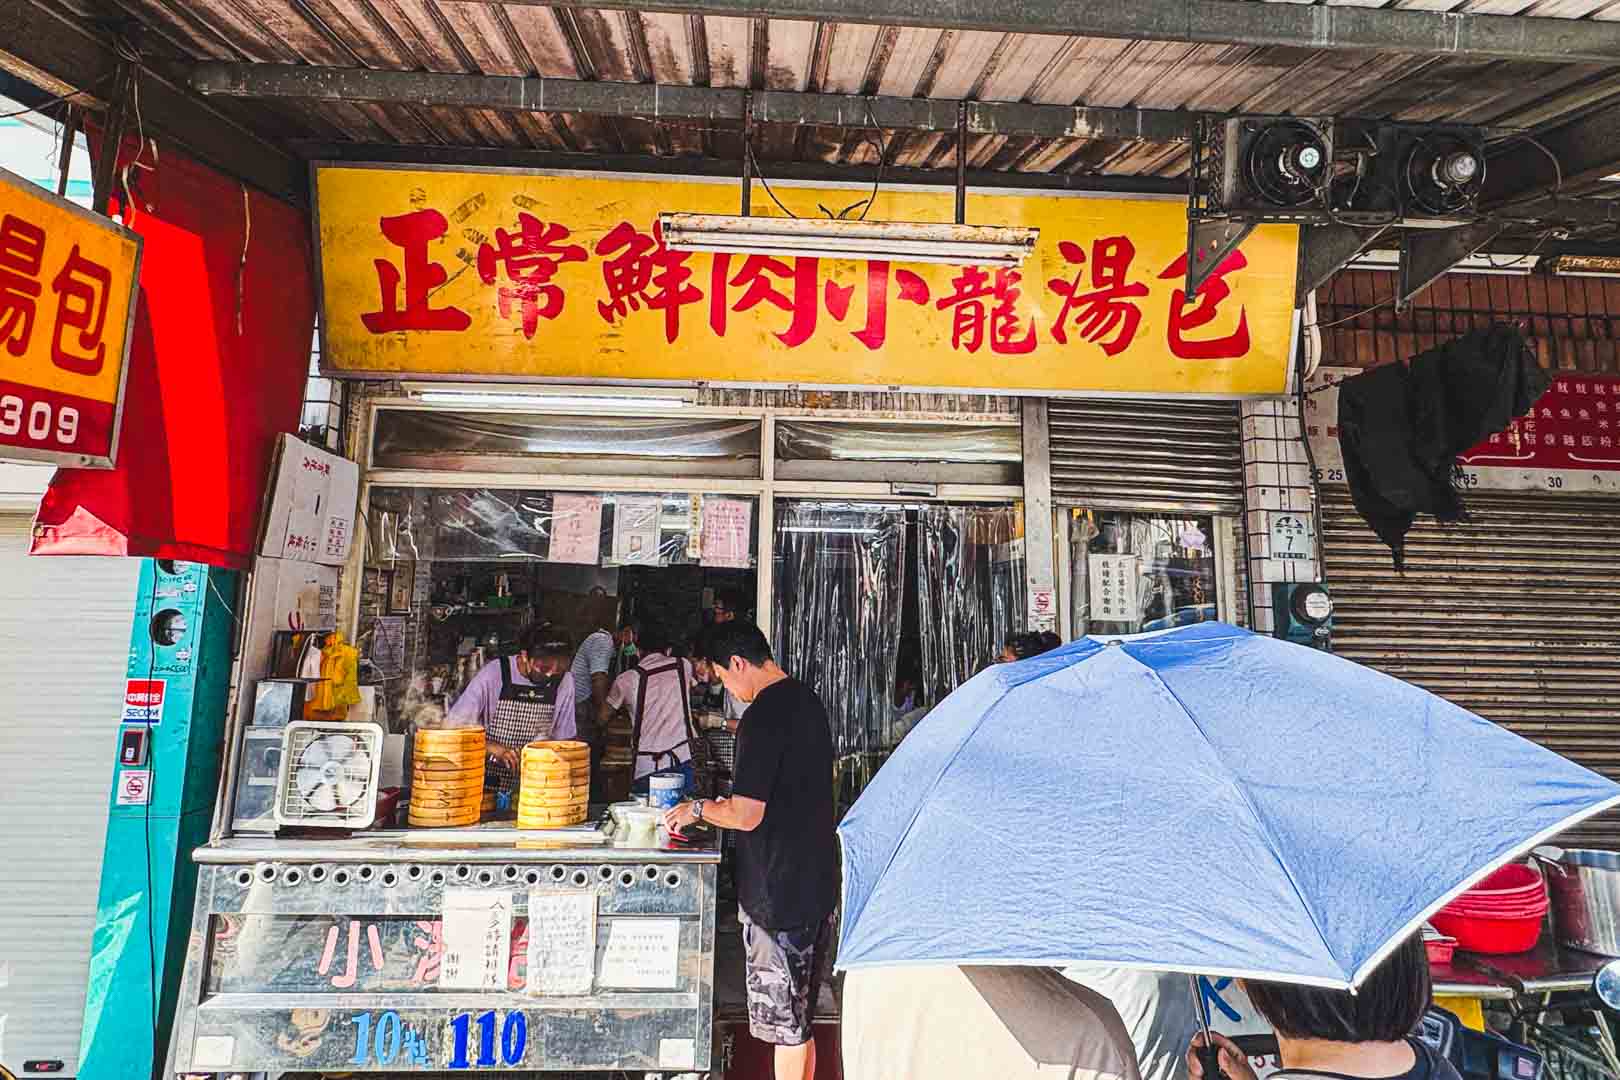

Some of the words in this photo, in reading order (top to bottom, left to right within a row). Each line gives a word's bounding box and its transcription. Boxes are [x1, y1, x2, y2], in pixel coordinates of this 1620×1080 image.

[1327, 469, 1343, 481] 25
[1548, 476, 1562, 488] 30
[126, 708, 160, 718] SECOM
[449, 1010, 528, 1069] 110
